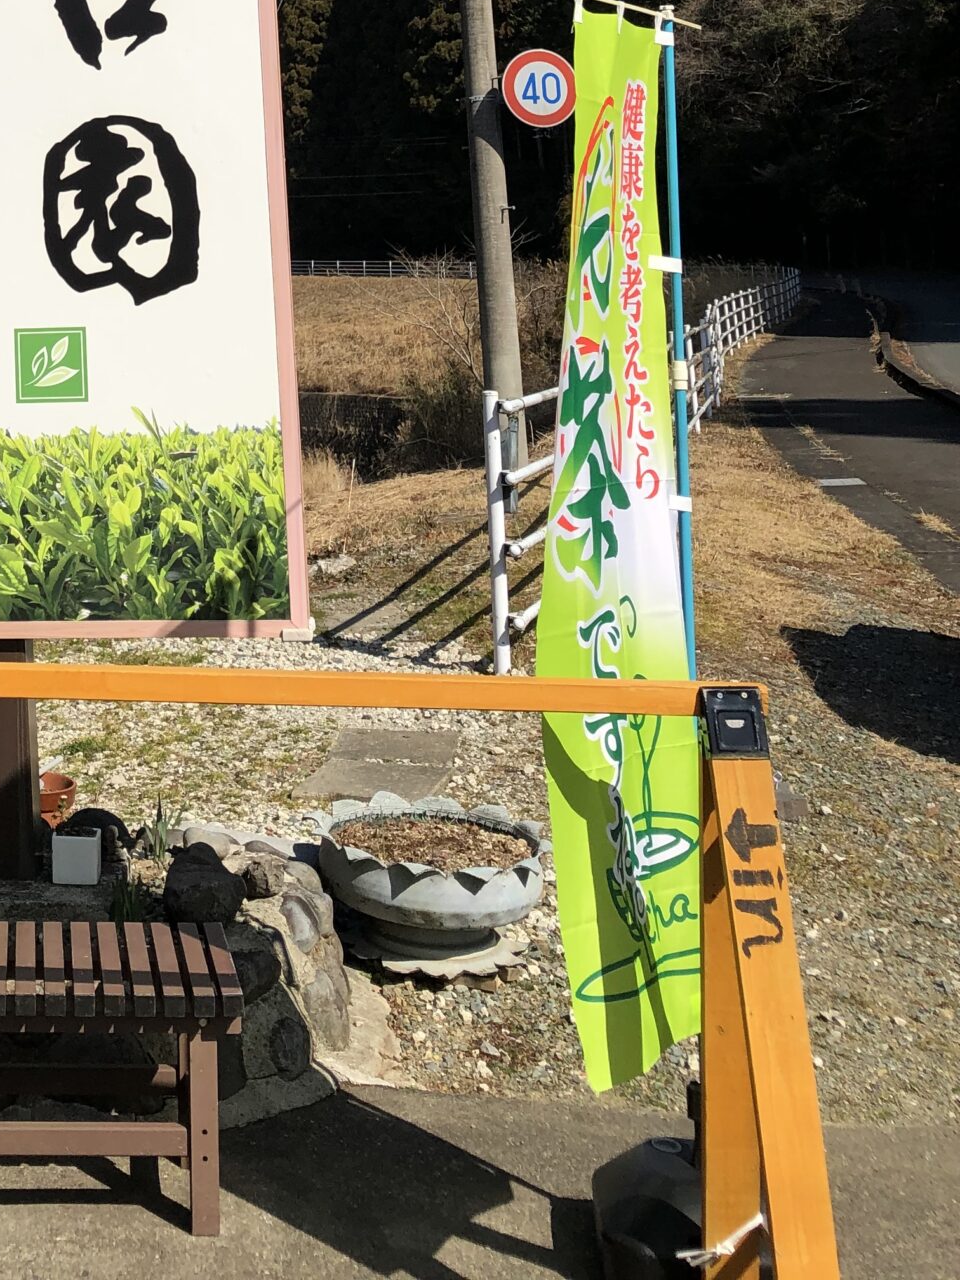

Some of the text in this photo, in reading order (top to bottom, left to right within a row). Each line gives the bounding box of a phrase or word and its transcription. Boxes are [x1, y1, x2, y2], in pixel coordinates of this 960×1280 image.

[521, 72, 562, 105] 40
[619, 83, 660, 499] 健康を考えたら
